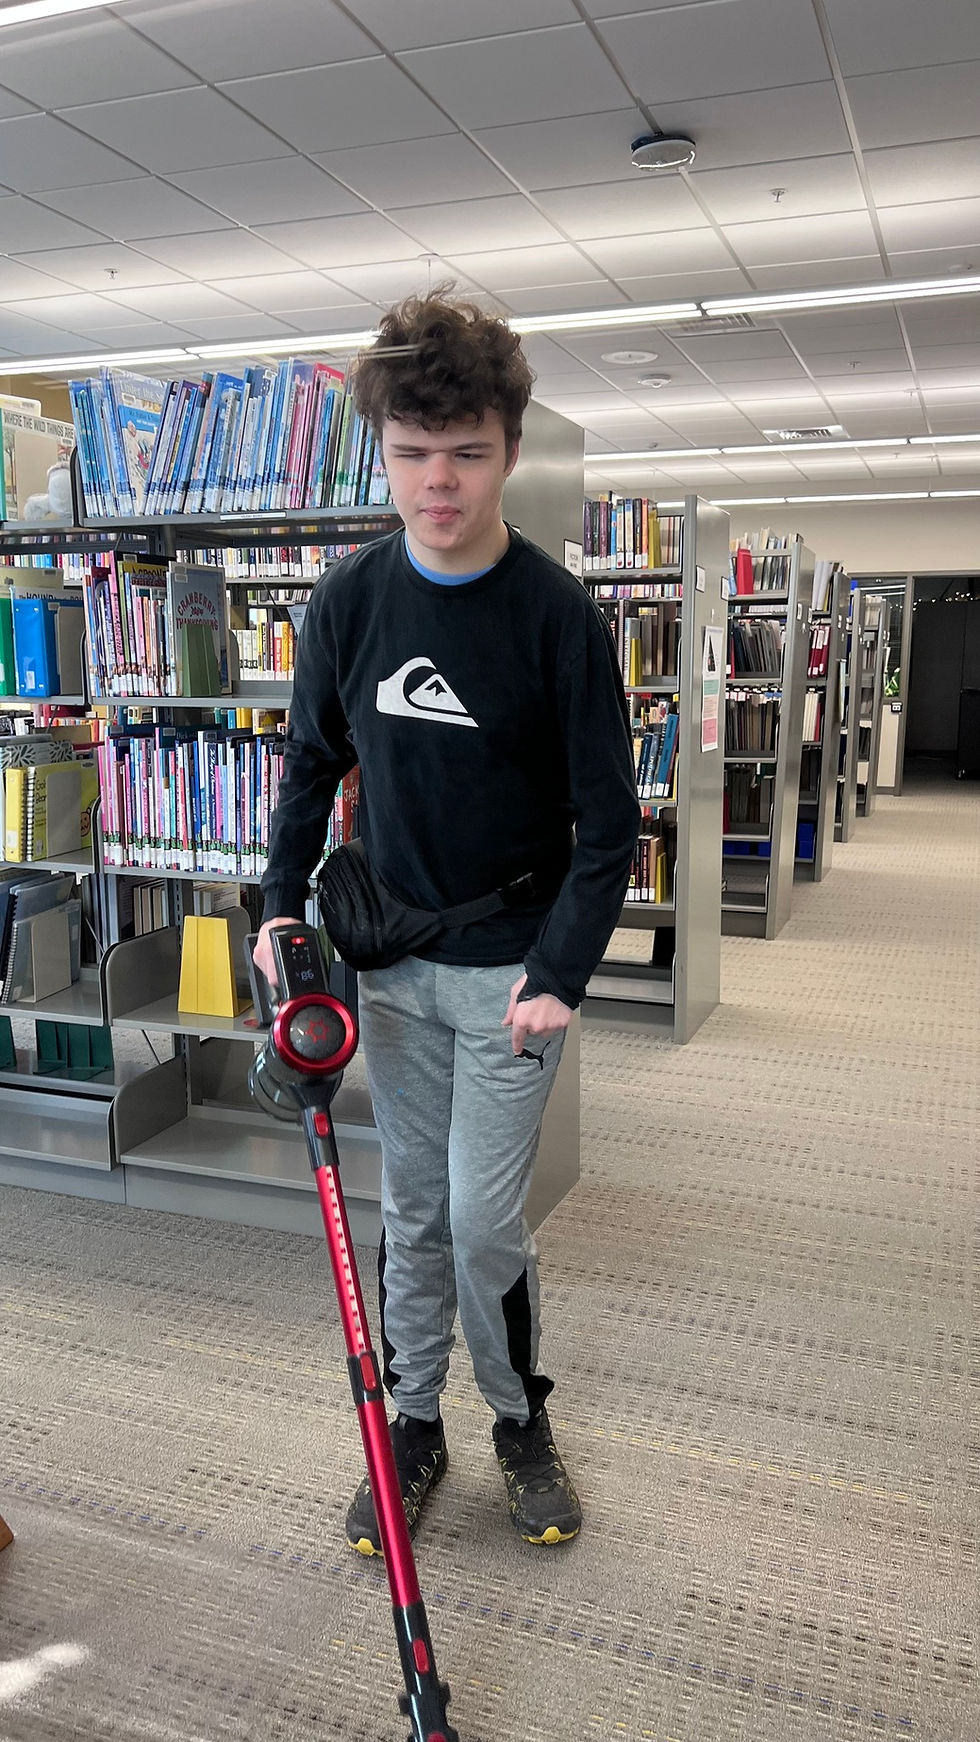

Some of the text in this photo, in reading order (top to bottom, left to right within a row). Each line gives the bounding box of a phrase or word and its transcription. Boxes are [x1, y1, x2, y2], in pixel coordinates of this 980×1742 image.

[3, 411, 74, 440] WHERE THE WILD THINGS ARE
[177, 591, 216, 616] CRANBERRY
